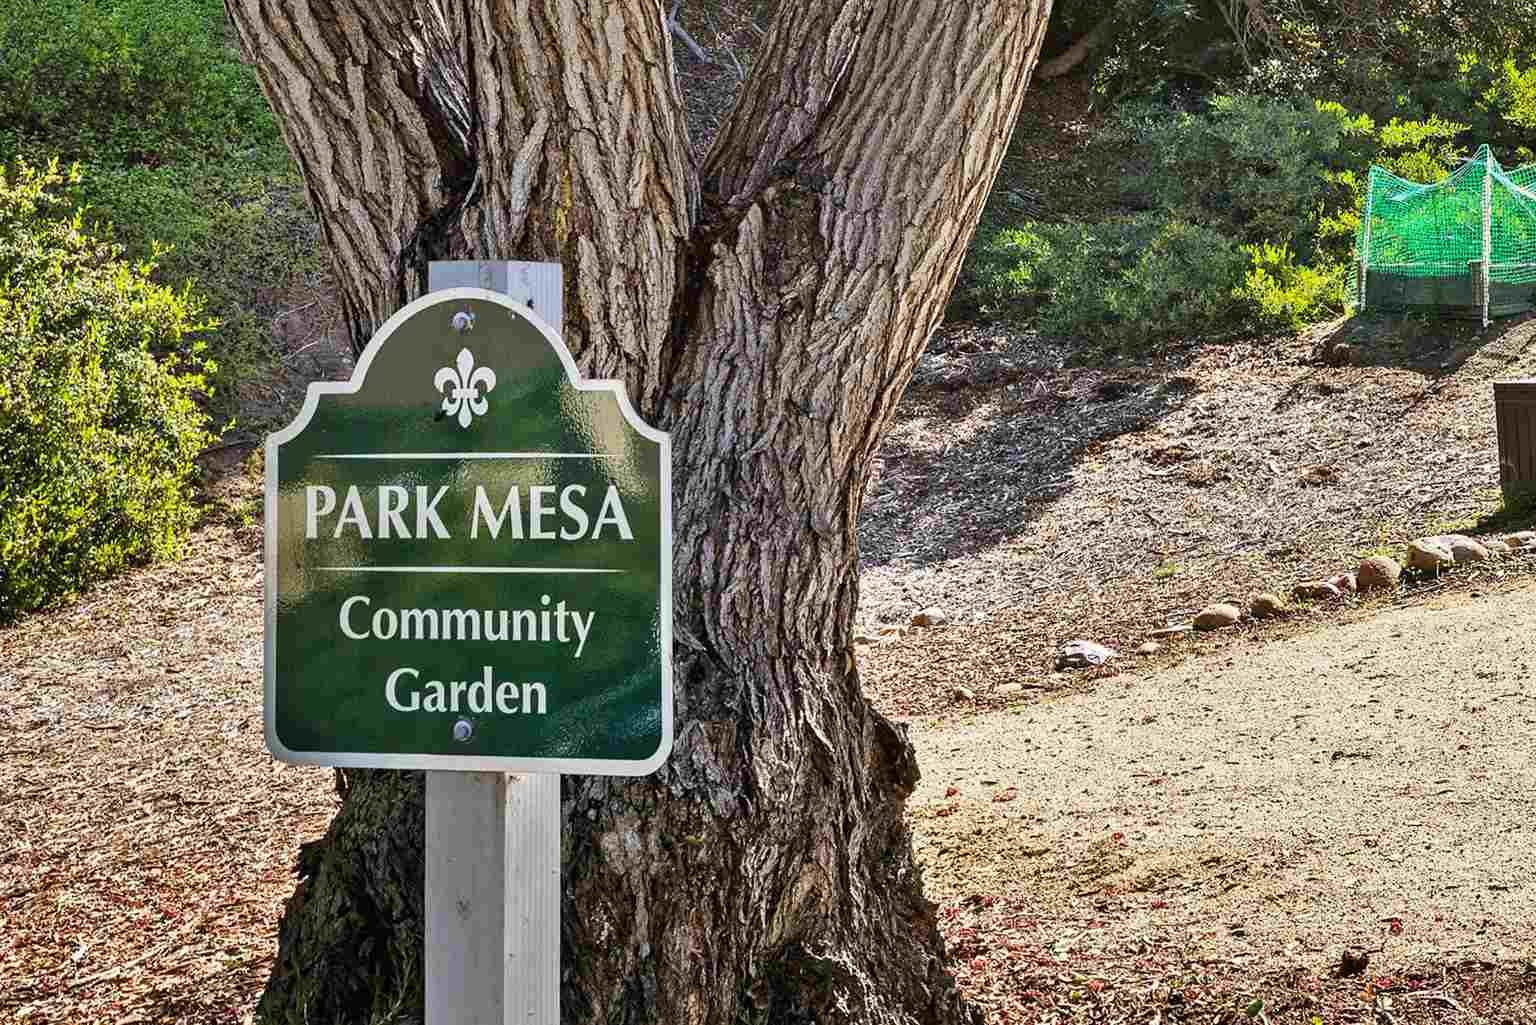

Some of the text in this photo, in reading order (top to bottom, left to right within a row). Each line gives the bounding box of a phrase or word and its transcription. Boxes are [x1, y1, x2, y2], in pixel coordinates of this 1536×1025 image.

[305, 484, 634, 541] PARK MESA
[339, 594, 596, 658] Community
[385, 666, 547, 714] Garden
